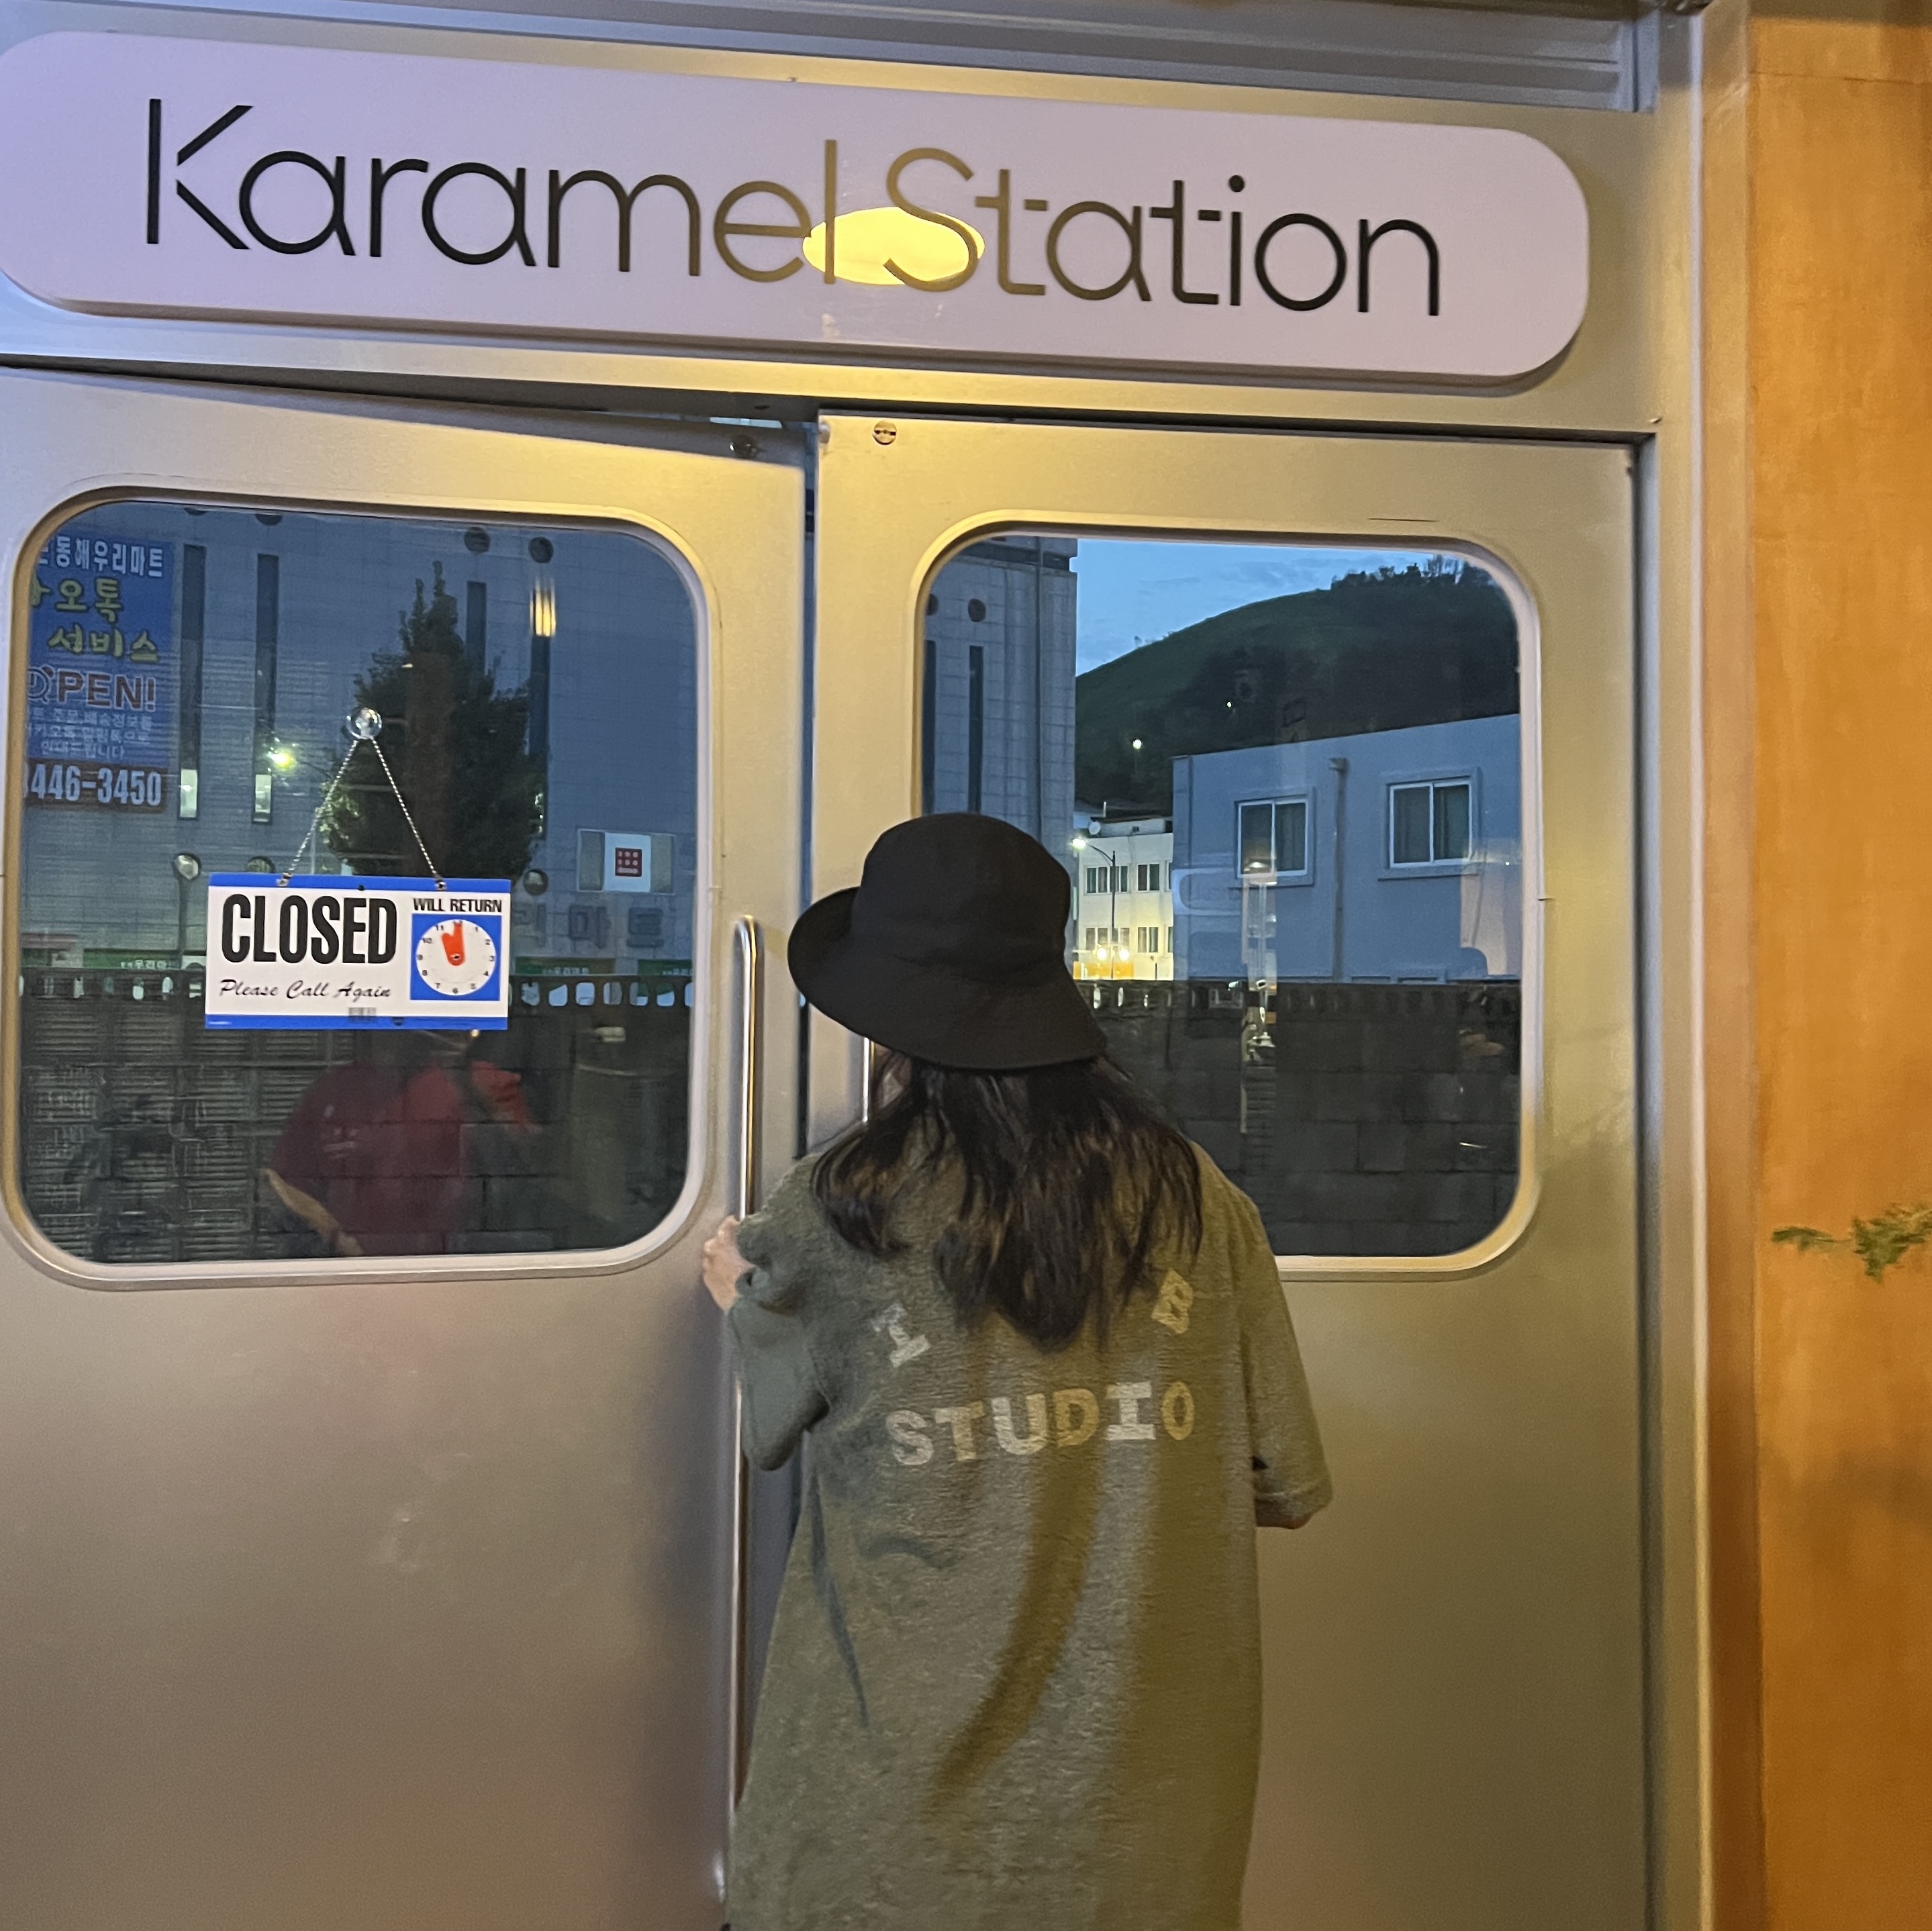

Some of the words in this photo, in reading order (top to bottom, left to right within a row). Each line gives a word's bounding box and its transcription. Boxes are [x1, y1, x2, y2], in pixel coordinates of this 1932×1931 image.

[146, 98, 836, 285] Karamel
[883, 147, 1441, 317] Station
[47, 623, 158, 662] 서비스
[222, 893, 397, 964] CLOSED
[413, 898, 445, 911] WILL
[450, 899, 502, 912] RETURN
[220, 979, 279, 996] Please
[286, 980, 330, 999] Call
[333, 981, 391, 1002] Again
[885, 1380, 1195, 1466] STUDIO
